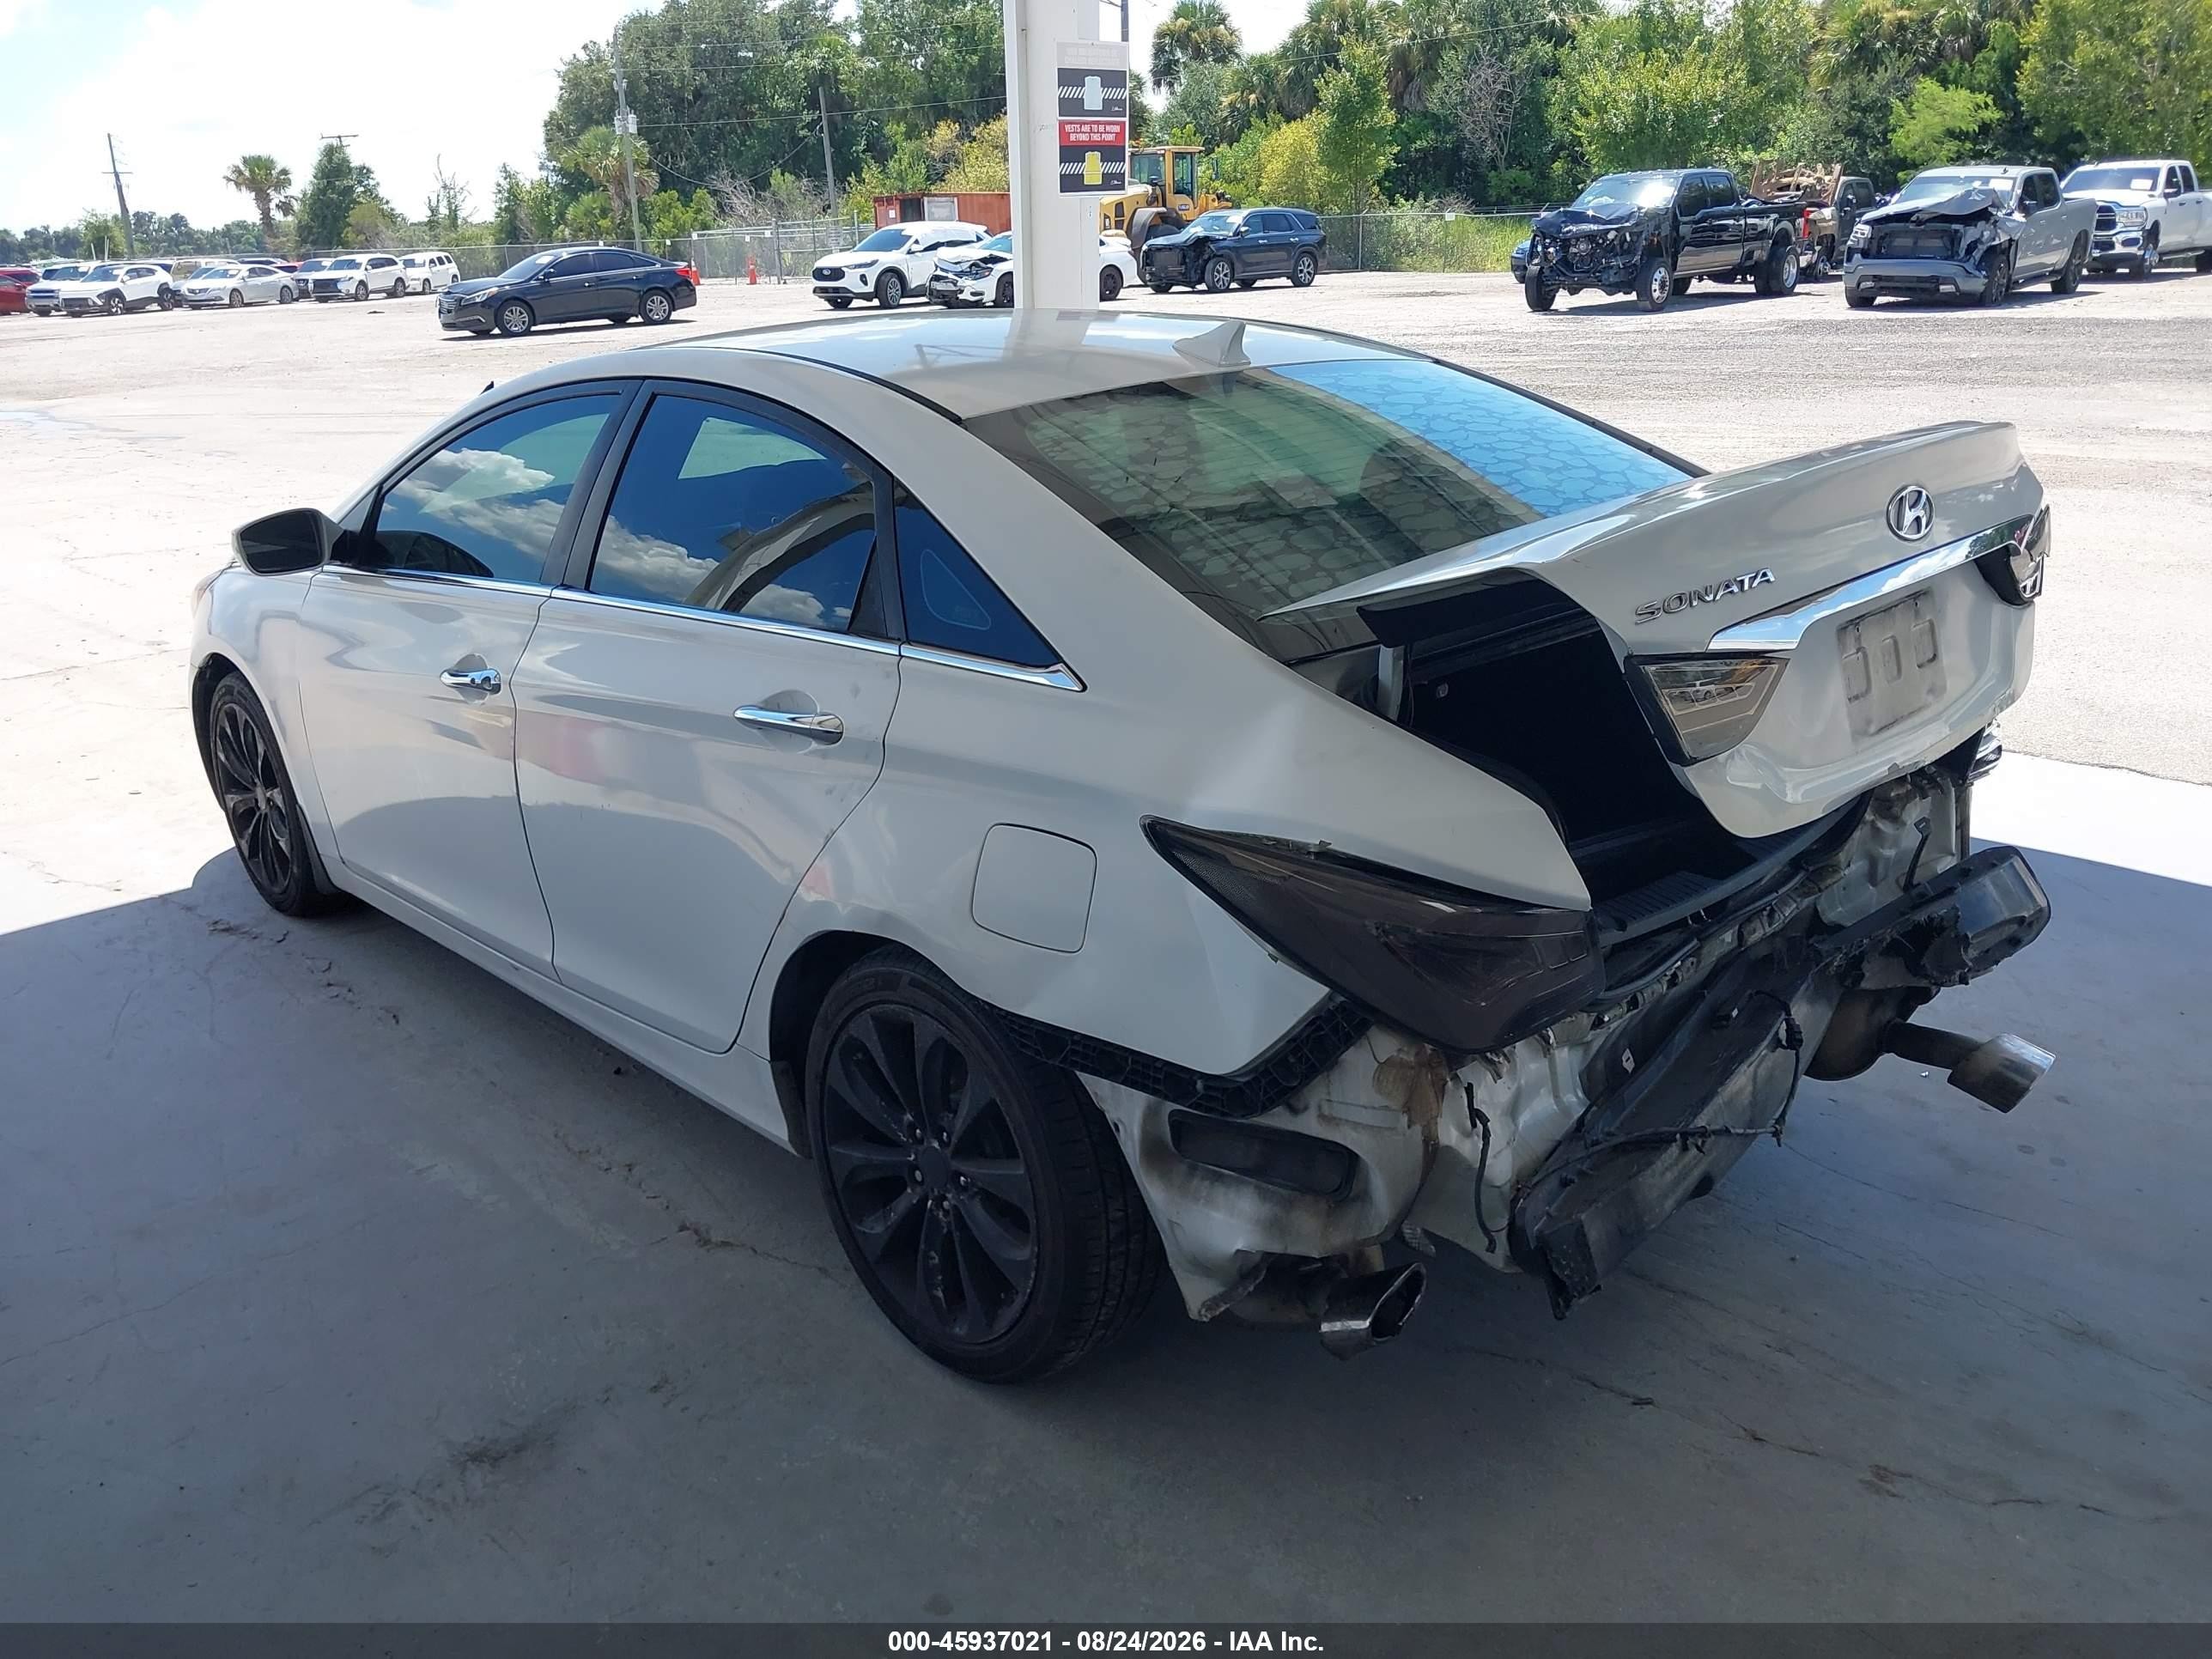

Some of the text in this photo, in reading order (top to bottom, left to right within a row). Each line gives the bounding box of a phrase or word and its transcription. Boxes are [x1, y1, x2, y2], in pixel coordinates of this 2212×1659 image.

[1065, 124, 1080, 132] VESTS
[1070, 133, 1090, 142] BEYOND
[1091, 133, 1101, 142] THIS
[1634, 568, 1775, 625] SONATA
